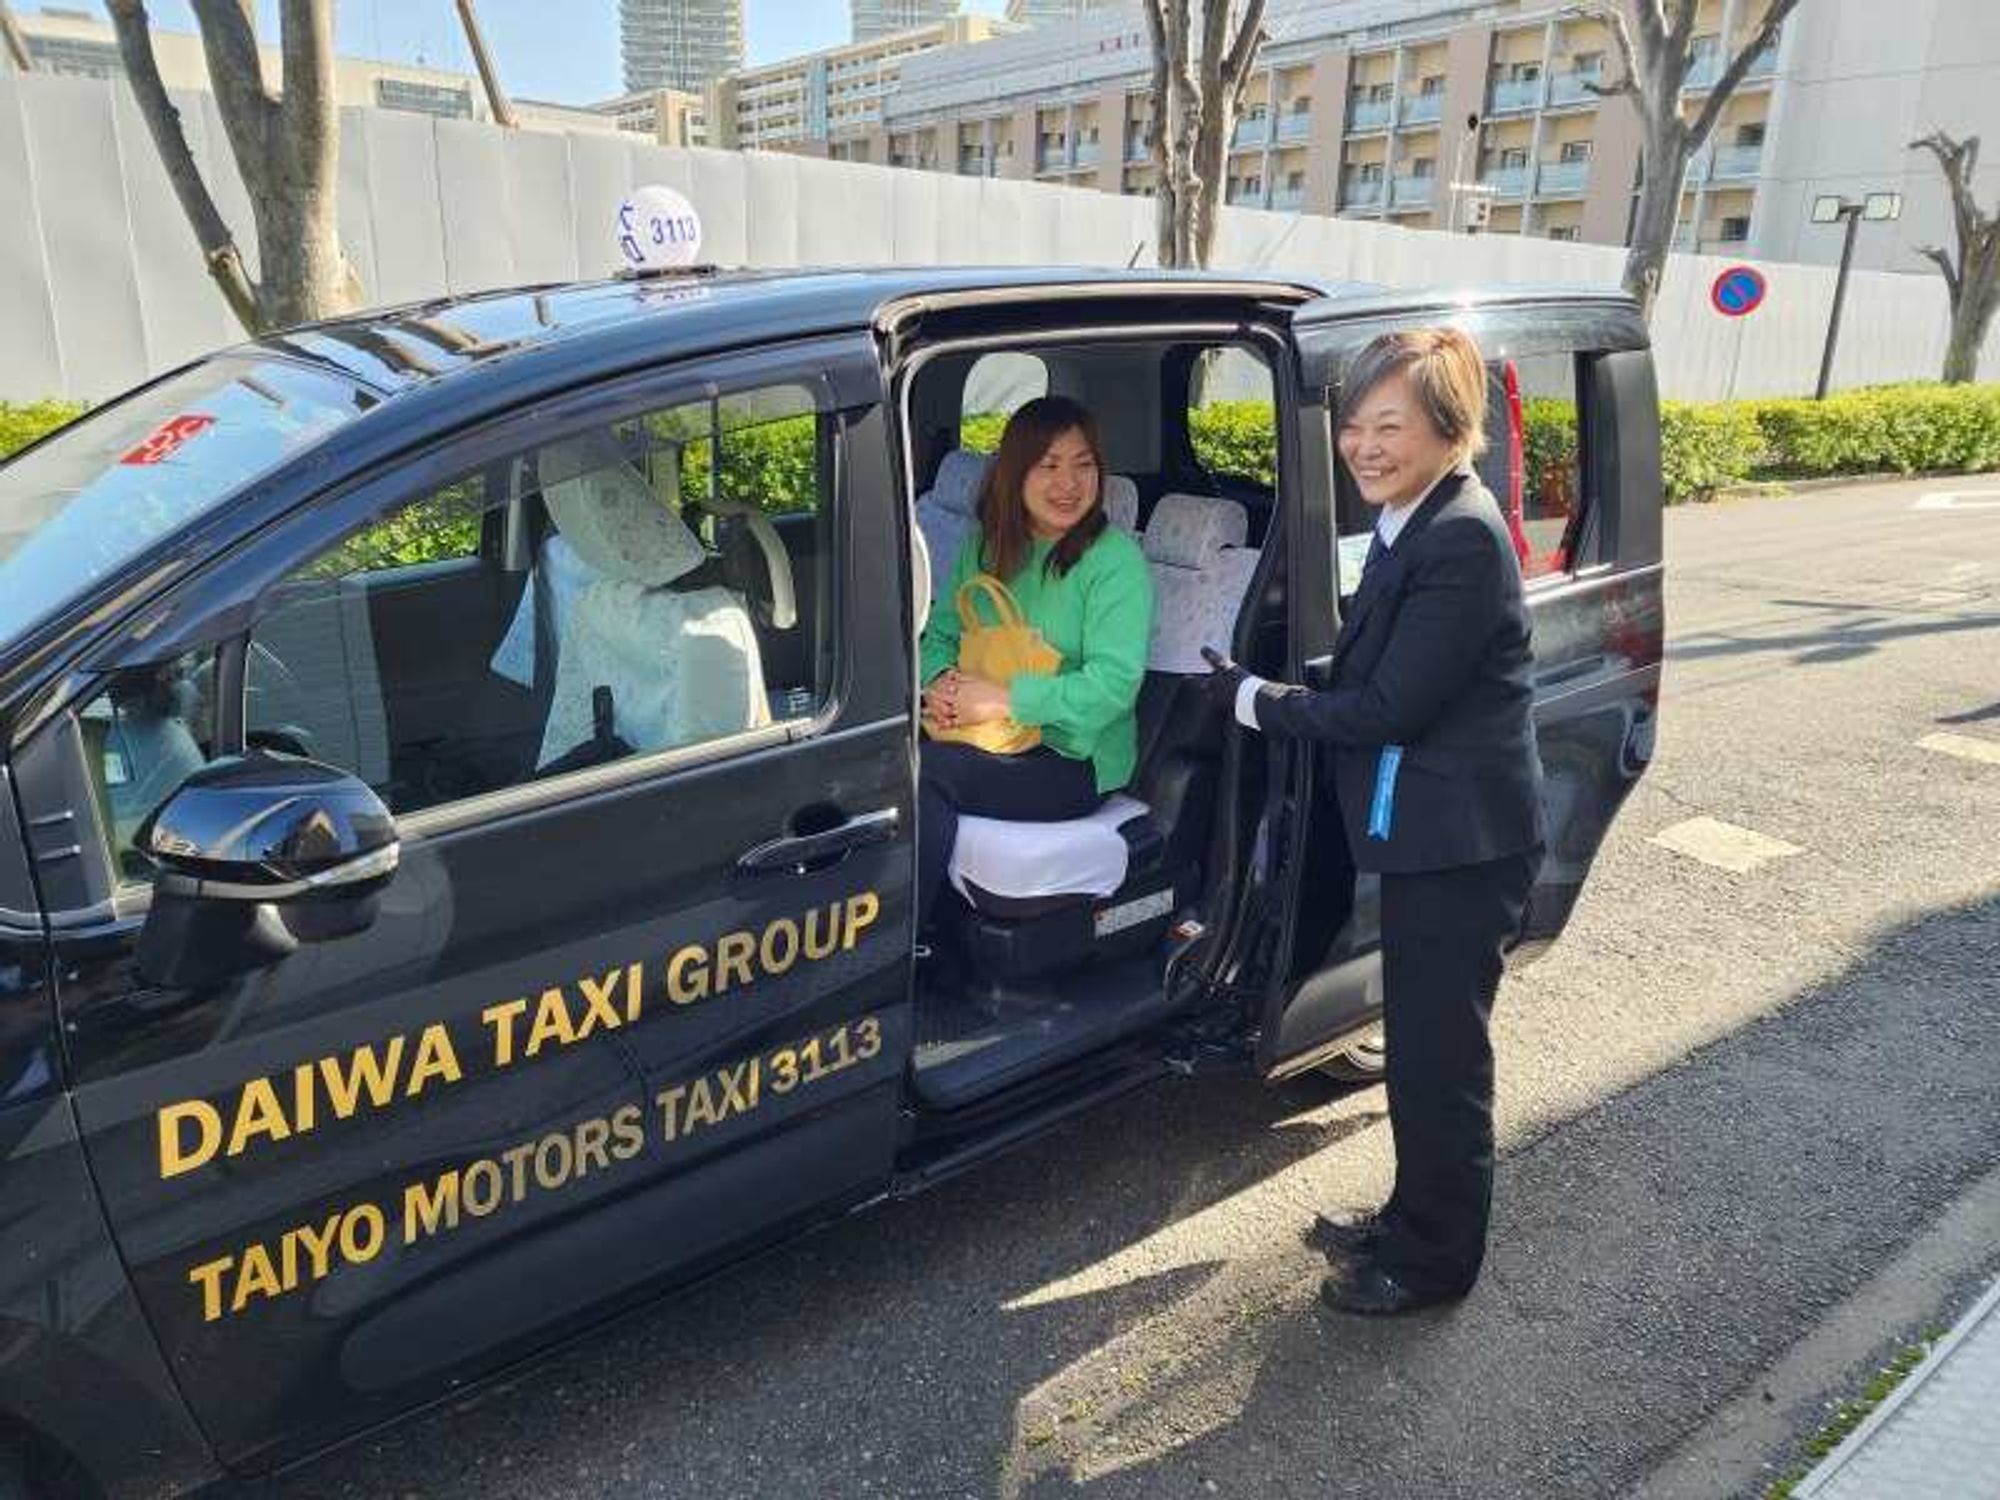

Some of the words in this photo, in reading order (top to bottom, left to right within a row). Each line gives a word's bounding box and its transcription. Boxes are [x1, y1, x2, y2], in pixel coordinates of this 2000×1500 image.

[650, 217, 696, 244] 3113
[159, 1037, 463, 1179] DAIWA
[482, 962, 644, 1067] TAXI
[666, 891, 880, 1005] GROUP
[190, 1203, 385, 1322] TAIYO
[404, 1105, 645, 1244] MOTORS
[657, 1057, 760, 1142] TAXI
[770, 1016, 882, 1094] 3113
